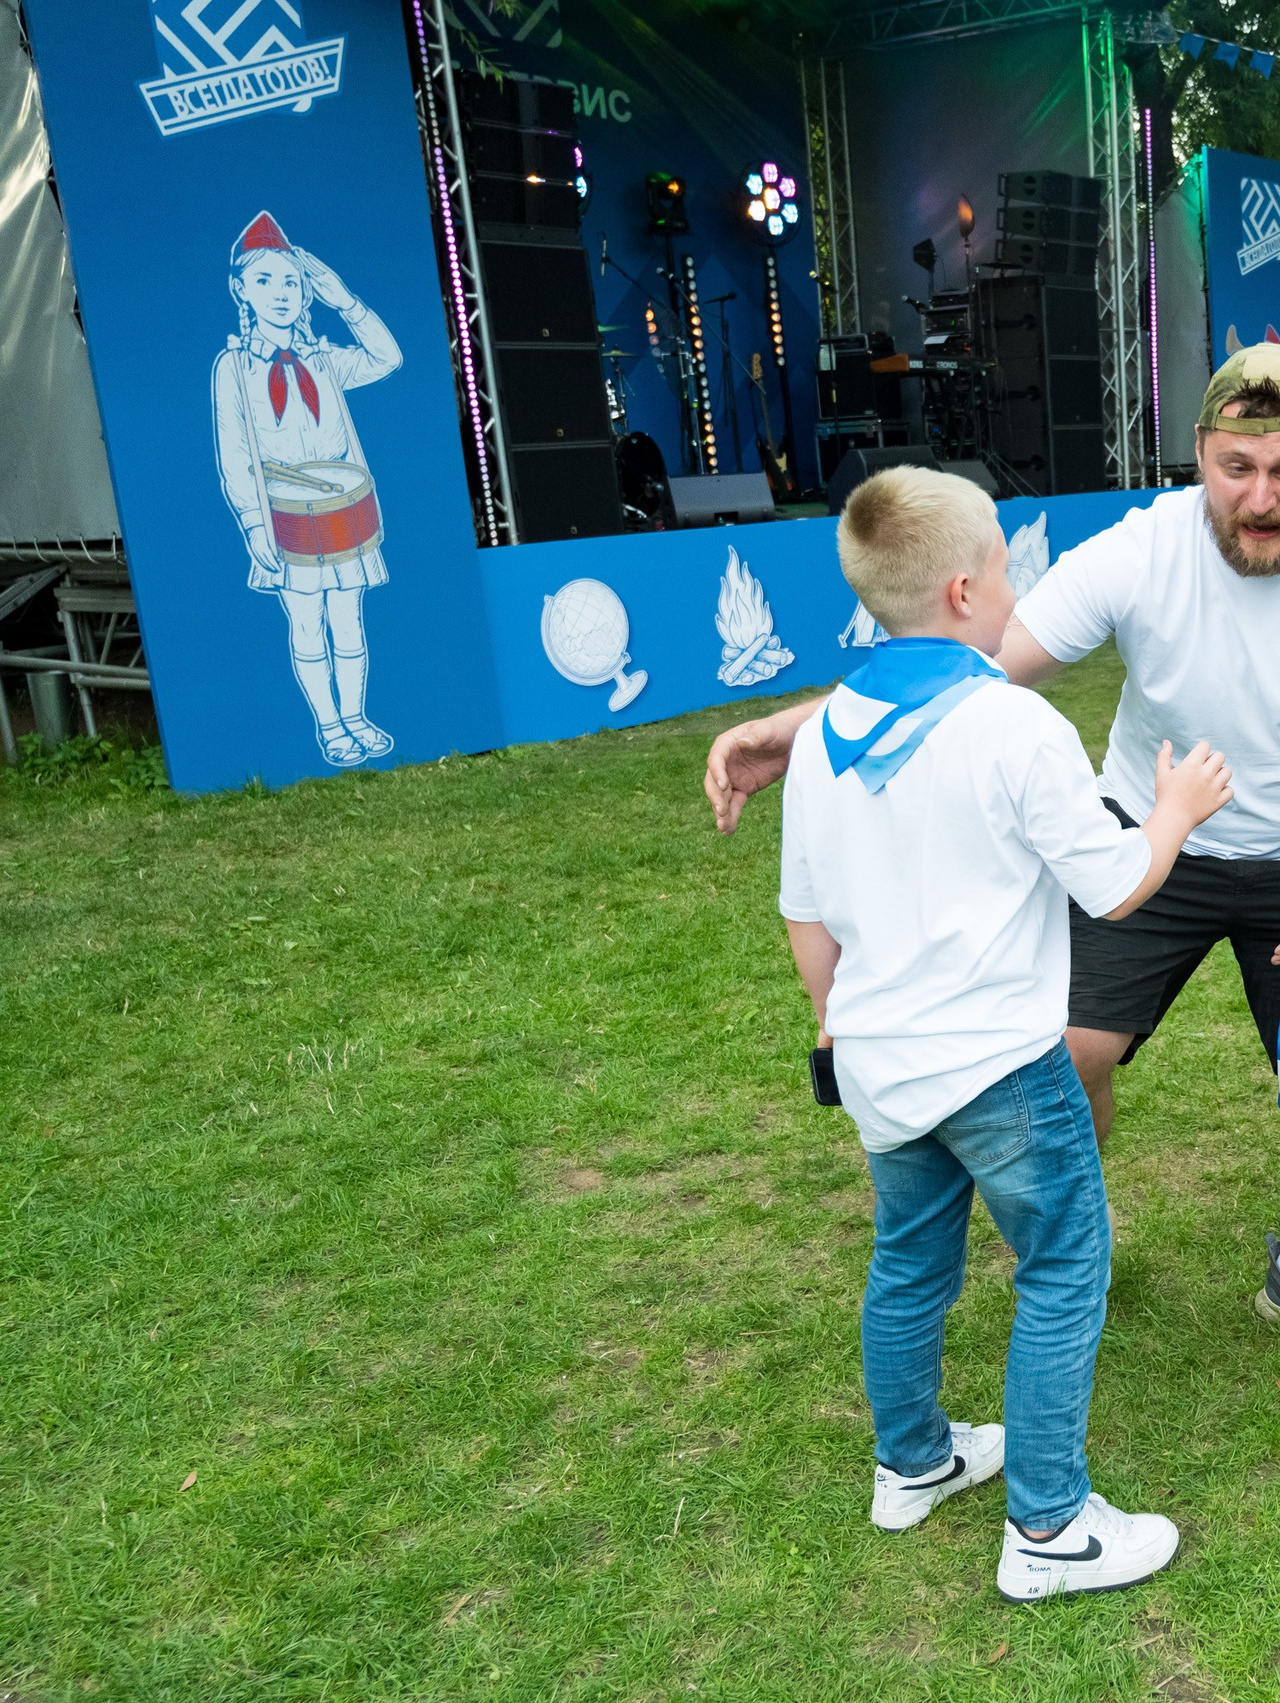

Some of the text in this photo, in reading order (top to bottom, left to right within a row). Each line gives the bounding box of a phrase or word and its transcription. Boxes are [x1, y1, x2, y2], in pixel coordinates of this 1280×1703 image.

[168, 56, 332, 118] ВСЕГДА ГОТОВ!
[1027, 1586, 1040, 1594] AIR
